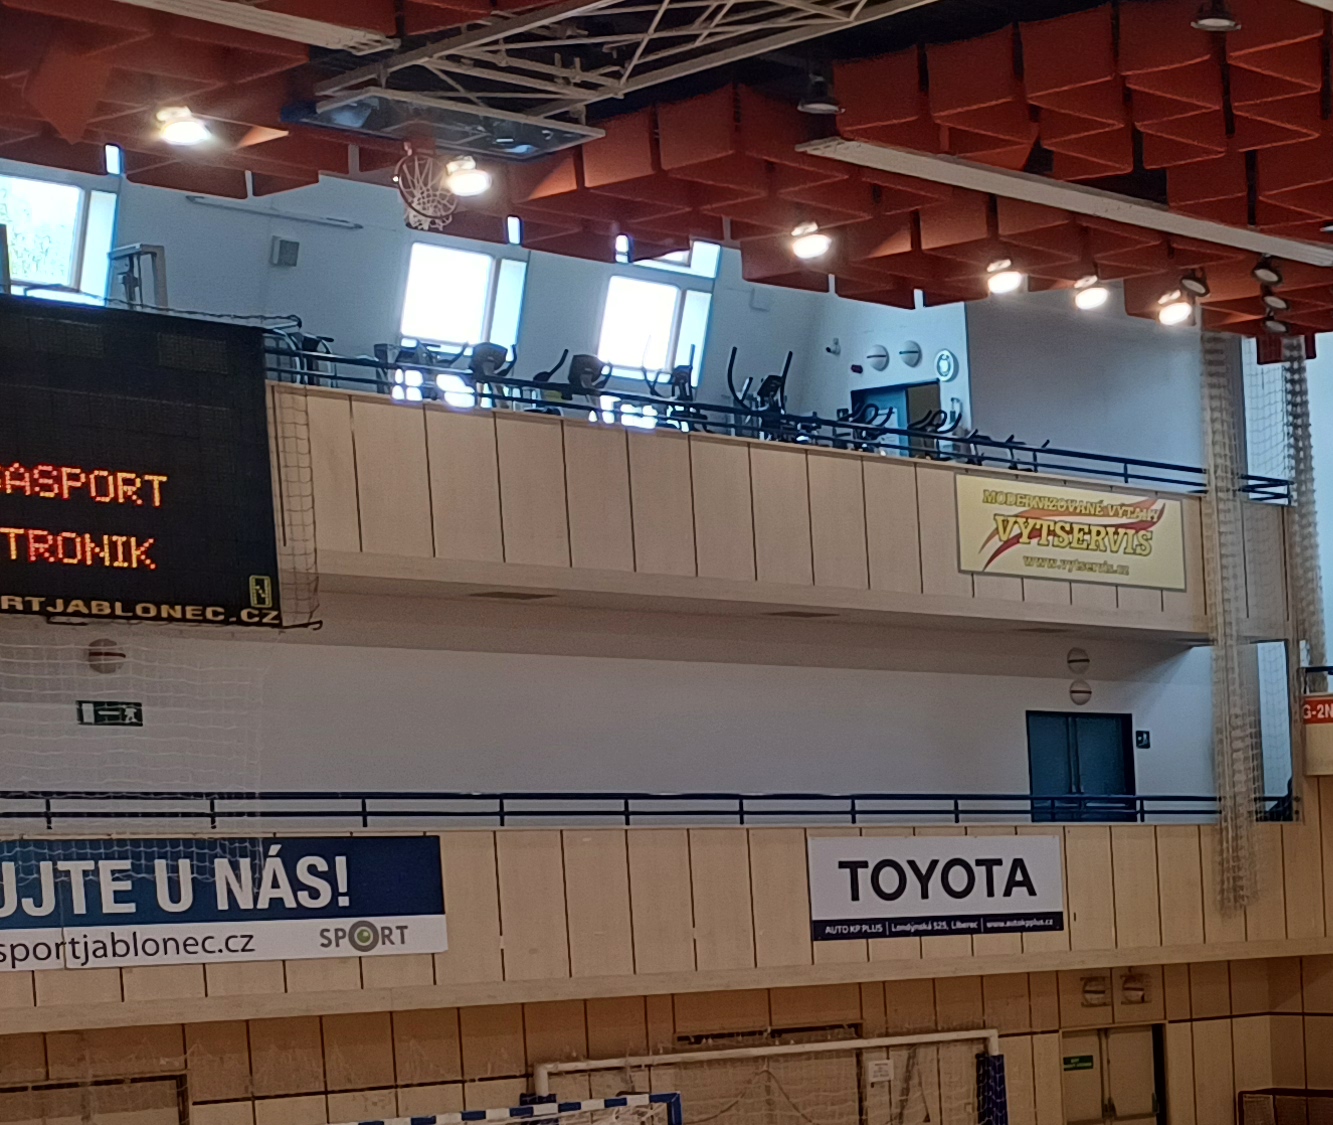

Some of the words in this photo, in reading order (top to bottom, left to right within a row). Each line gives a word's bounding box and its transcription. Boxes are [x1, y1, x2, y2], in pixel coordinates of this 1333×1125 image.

[0, 462, 167, 507] ASPORT
[994, 514, 1153, 556] VYTSERVIS
[0, 595, 280, 624] RTJABLONEC.CZ
[154, 858, 194, 913] U
[214, 844, 350, 911] NÁS!
[838, 858, 1037, 901] TOYOTA
[825, 925, 849, 934] AUTO
[850, 924, 860, 933] KP
[862, 923, 883, 933] PLUS
